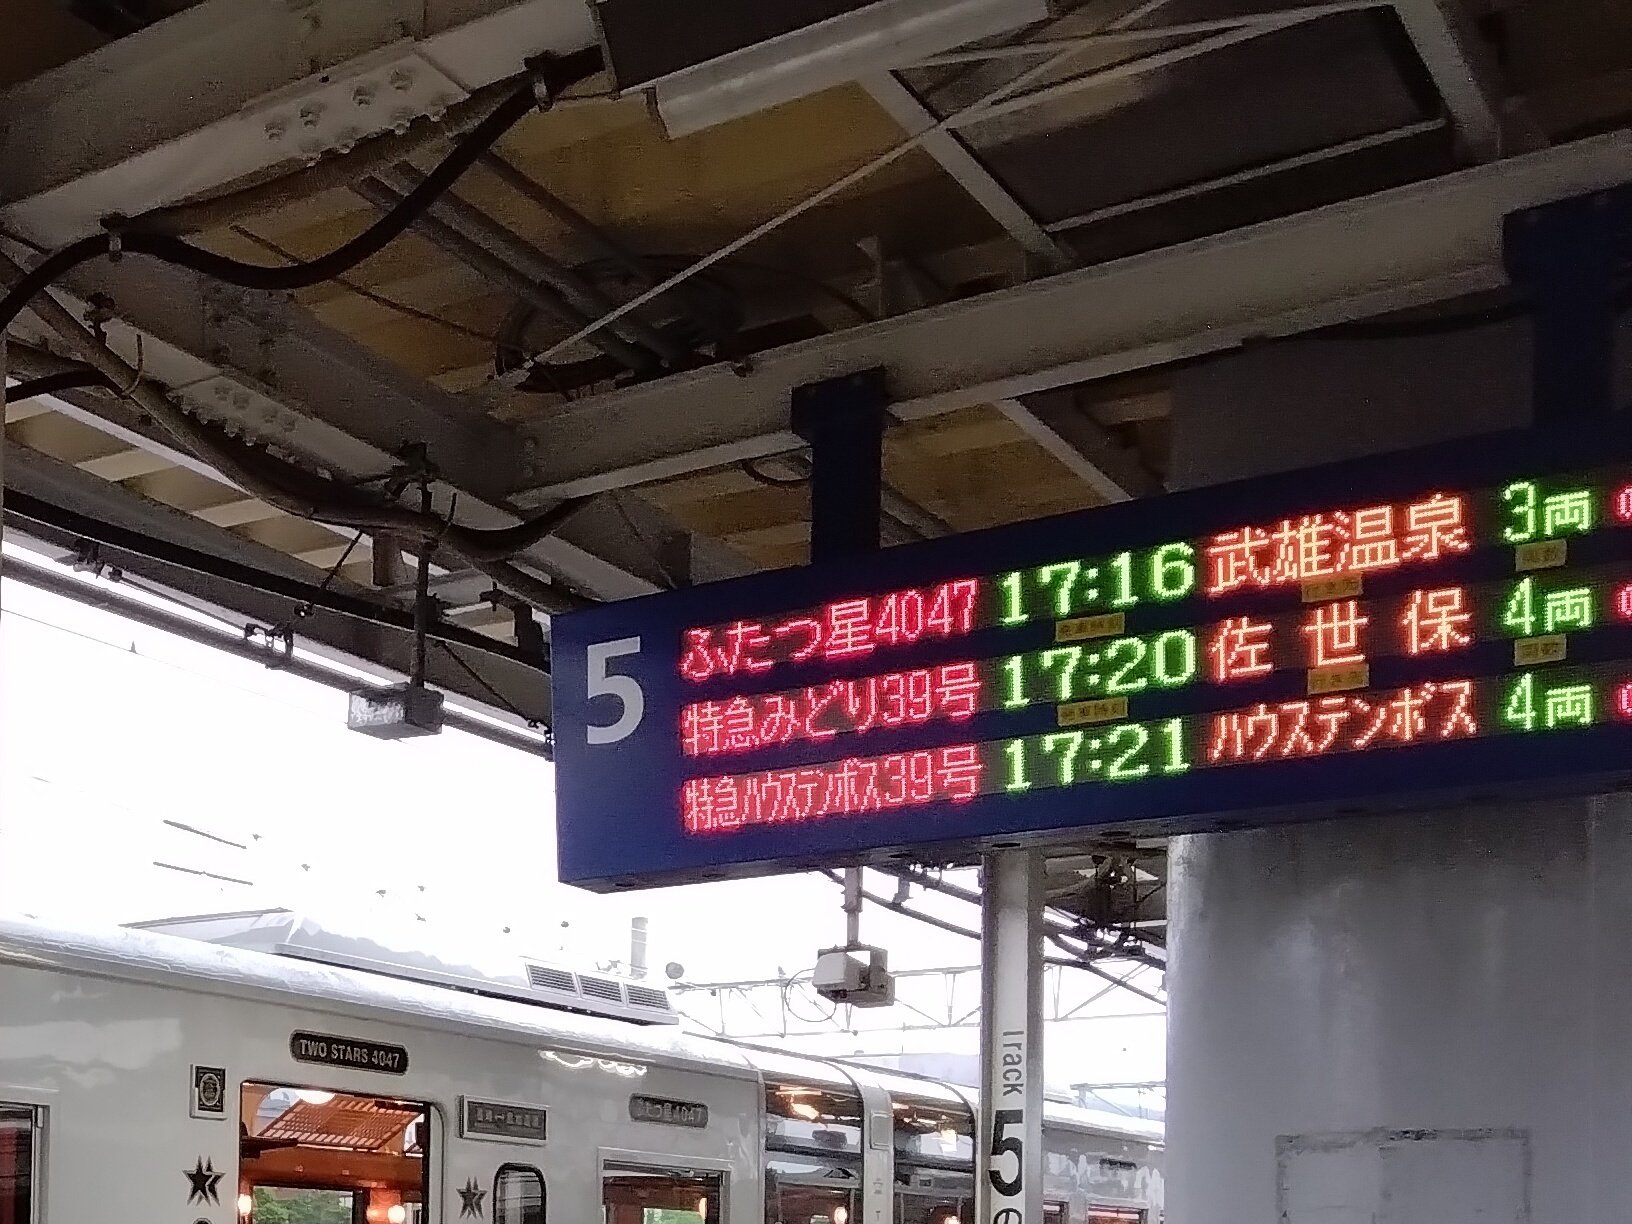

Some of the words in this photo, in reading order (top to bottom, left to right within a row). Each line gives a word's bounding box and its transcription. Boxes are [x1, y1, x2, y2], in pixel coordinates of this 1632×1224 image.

[680, 578, 977, 680] ふたつ星4047
[1001, 541, 1195, 625] 17:16
[1207, 493, 1469, 594] 武雄温泉
[587, 635, 645, 745] 5
[682, 661, 982, 757] 特急みどり39号
[1004, 629, 1196, 708] 17:20
[1005, 717, 1191, 791] 17:21
[1209, 681, 1476, 759] ハウステンボス
[300, 1040, 328, 1058] TWO
[331, 1043, 369, 1063] STARS
[371, 1050, 400, 1068] 4047
[988, 1108, 1025, 1197] 5
